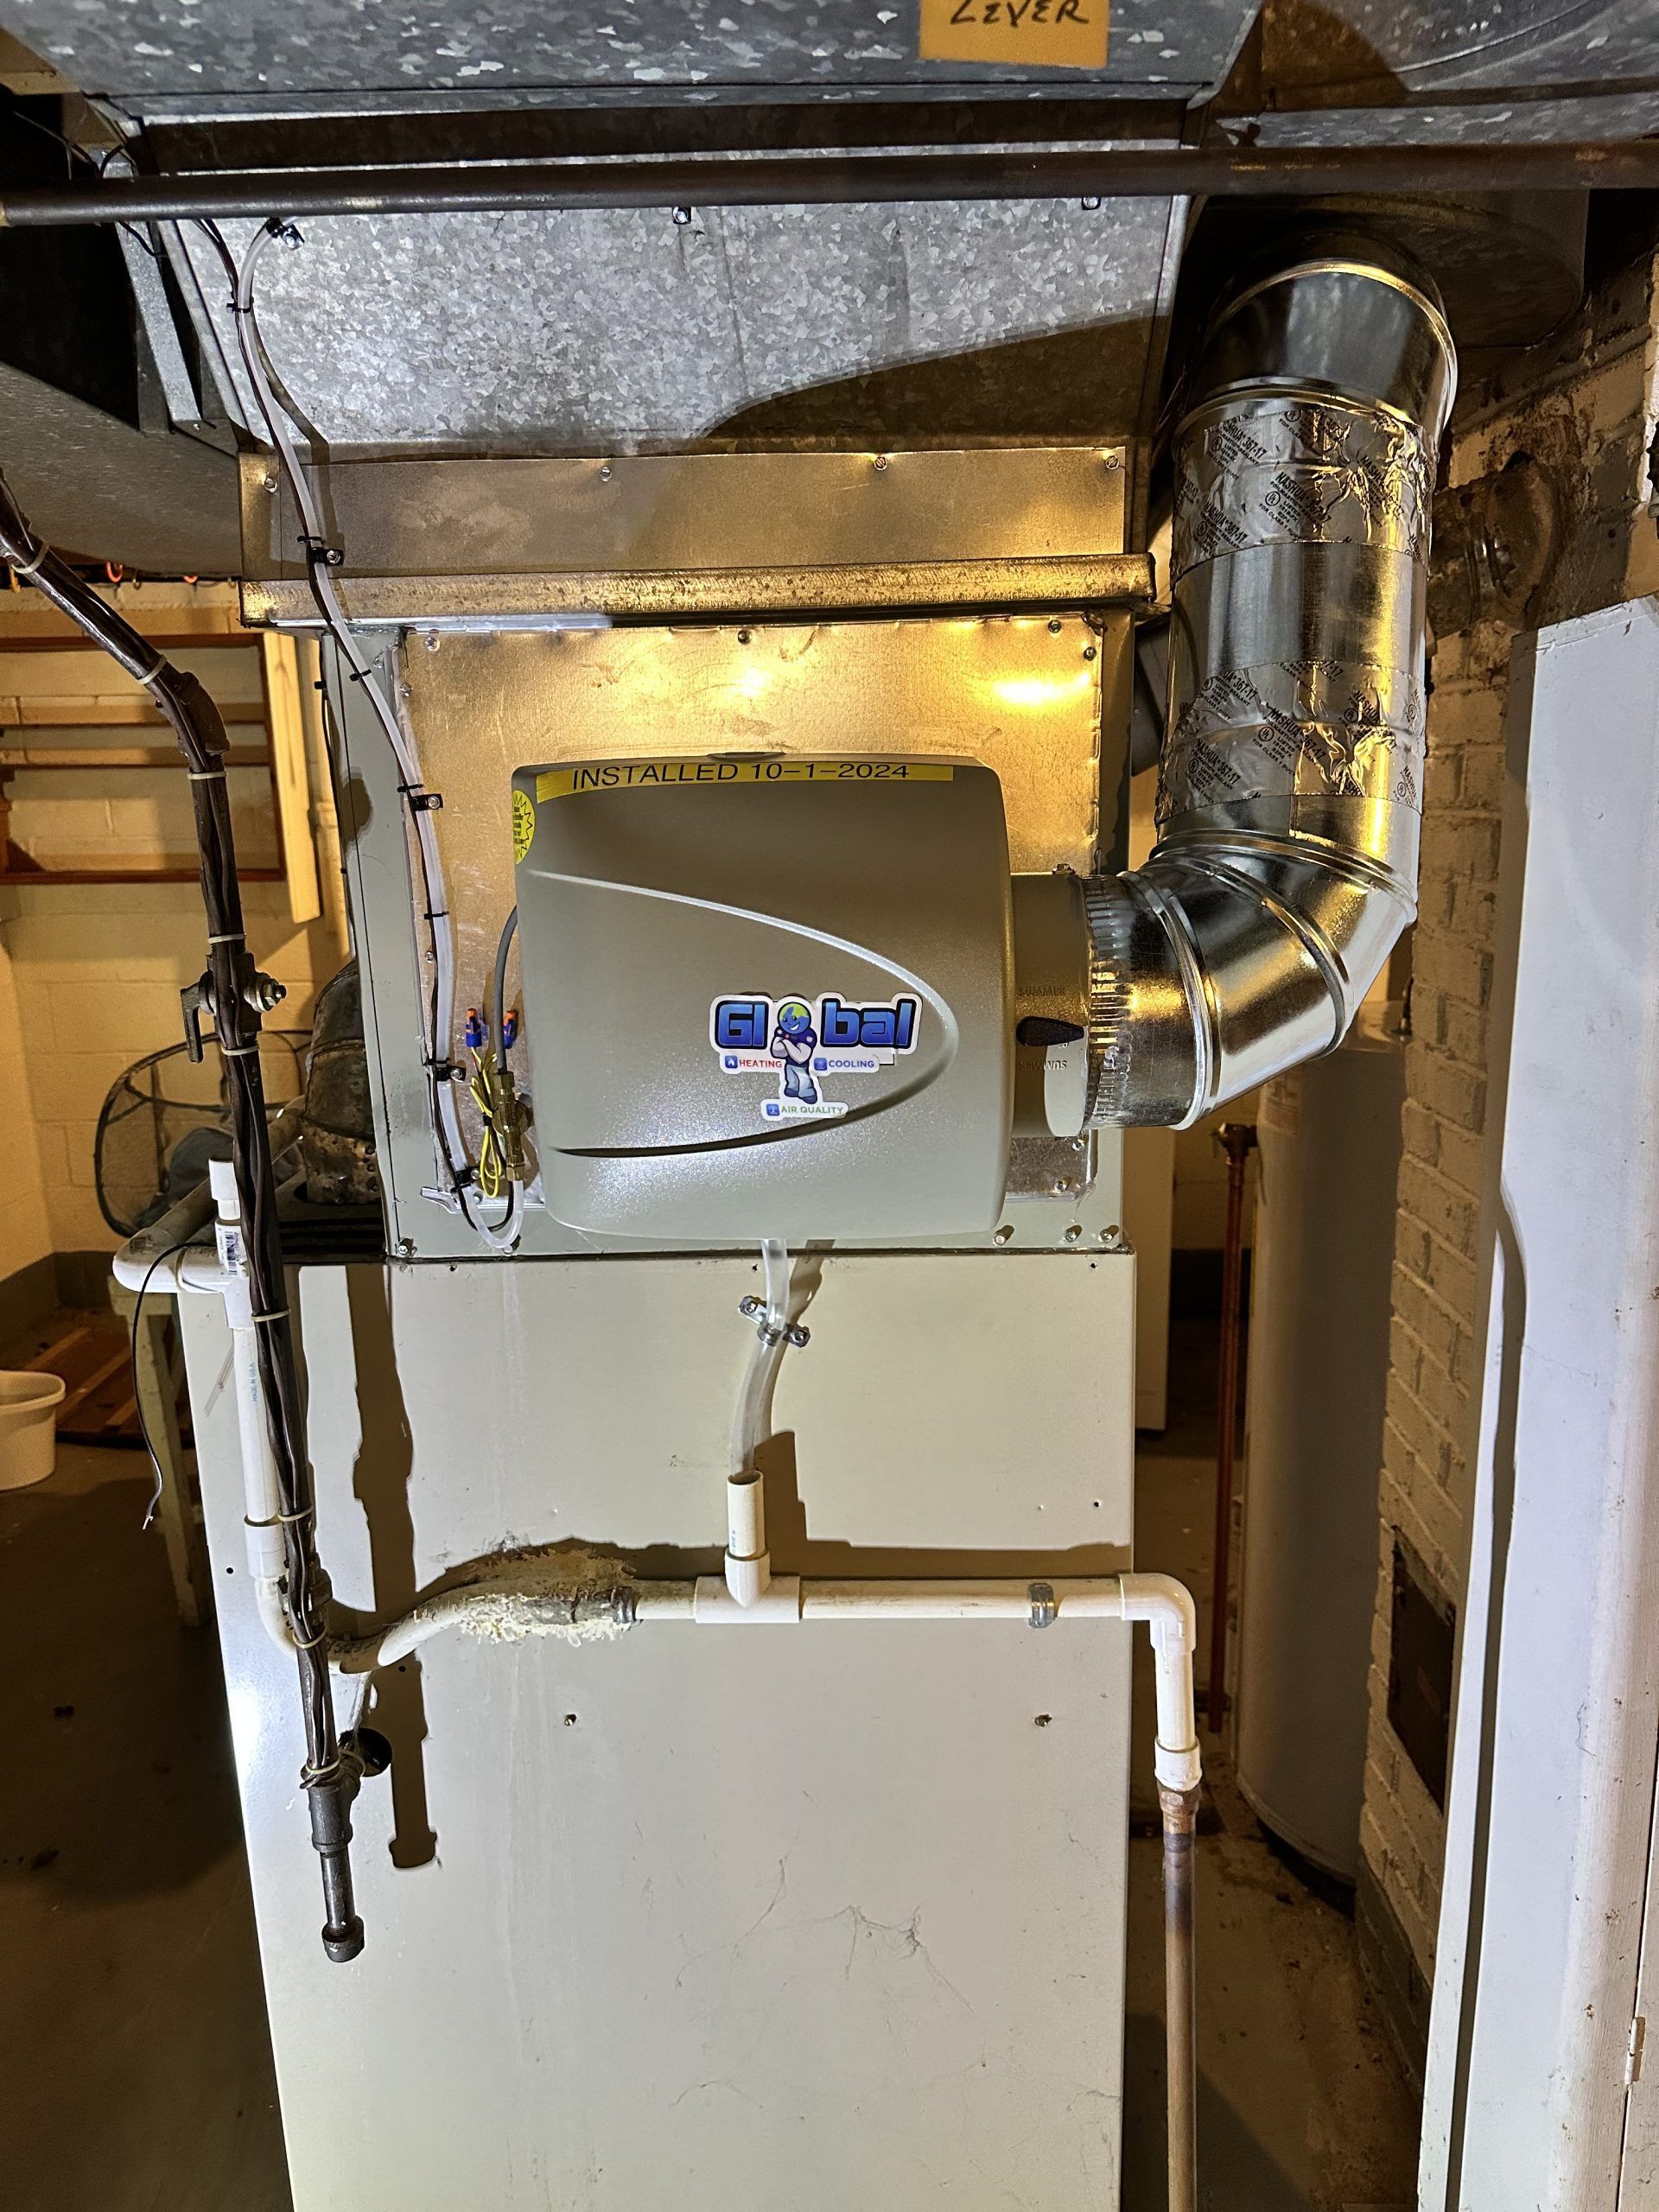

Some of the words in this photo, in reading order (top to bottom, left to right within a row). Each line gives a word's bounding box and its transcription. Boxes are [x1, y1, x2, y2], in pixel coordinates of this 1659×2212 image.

[1258, 502, 1269, 512] FOR
[1277, 736, 1295, 753] LISTED
[1252, 738, 1262, 747] FOR
[1262, 747, 1278, 762] CLASS
[573, 764, 739, 791] INSTALLED
[751, 763, 910, 780] 10-1-2024
[740, 1059, 782, 1068] HEATING
[829, 1059, 874, 1068] COOLING
[781, 1105, 798, 1114] AIR
[800, 1105, 843, 1115] QUALITY
